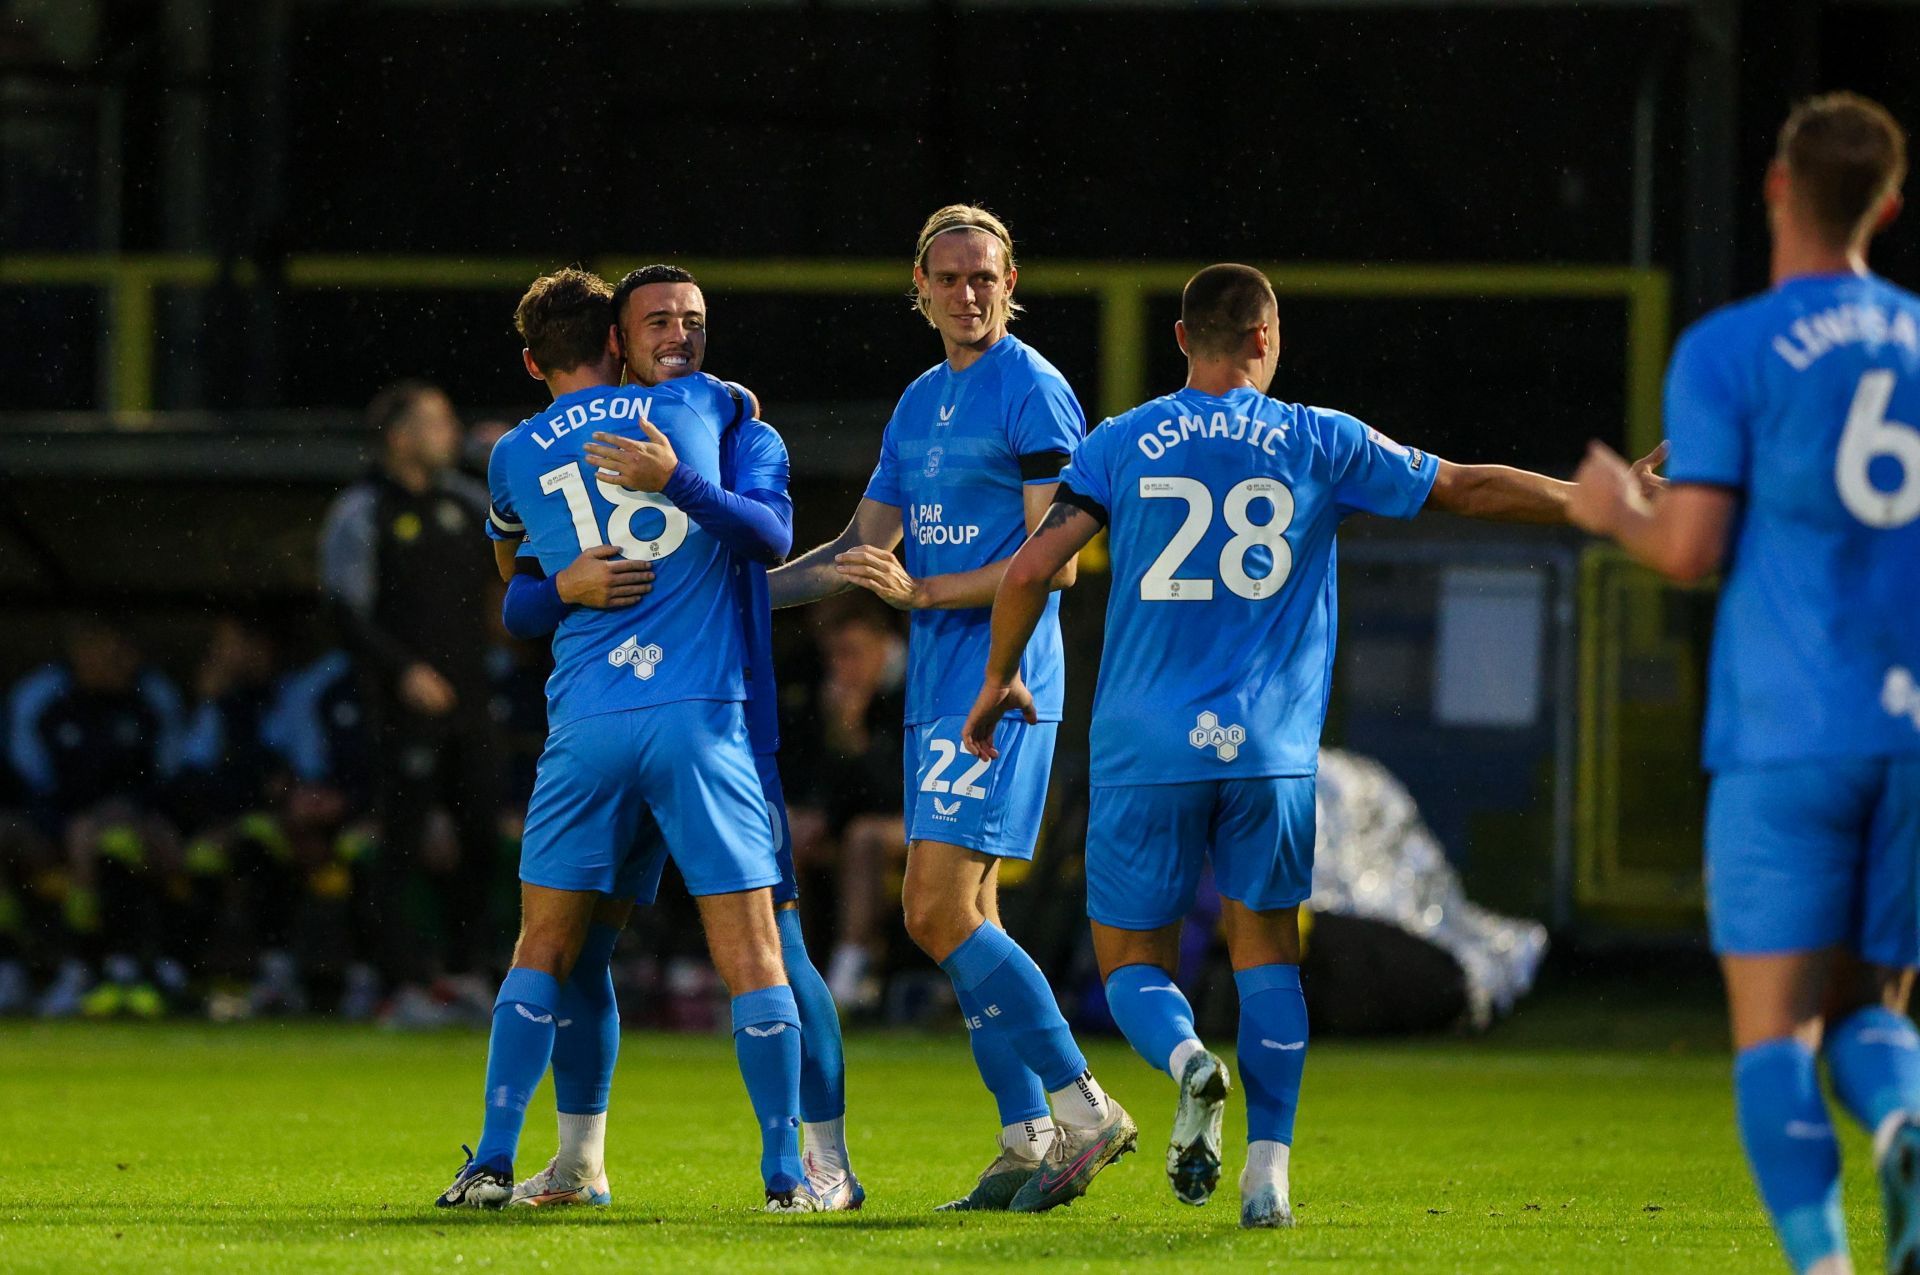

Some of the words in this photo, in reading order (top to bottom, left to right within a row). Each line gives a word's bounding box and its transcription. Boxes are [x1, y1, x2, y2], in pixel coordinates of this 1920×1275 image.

[531, 397, 653, 450] LEDSON
[1138, 412, 1290, 460] OSMAJIĆ
[1834, 369, 1920, 529] 6
[538, 461, 690, 562] 18
[919, 525, 980, 546] GROUP
[920, 504, 943, 524] PAR
[1139, 476, 1295, 600] 28
[615, 649, 657, 662] PAR
[1196, 730, 1240, 743] PAR
[919, 738, 992, 800] 22
[1023, 1119, 1038, 1142] IGN
